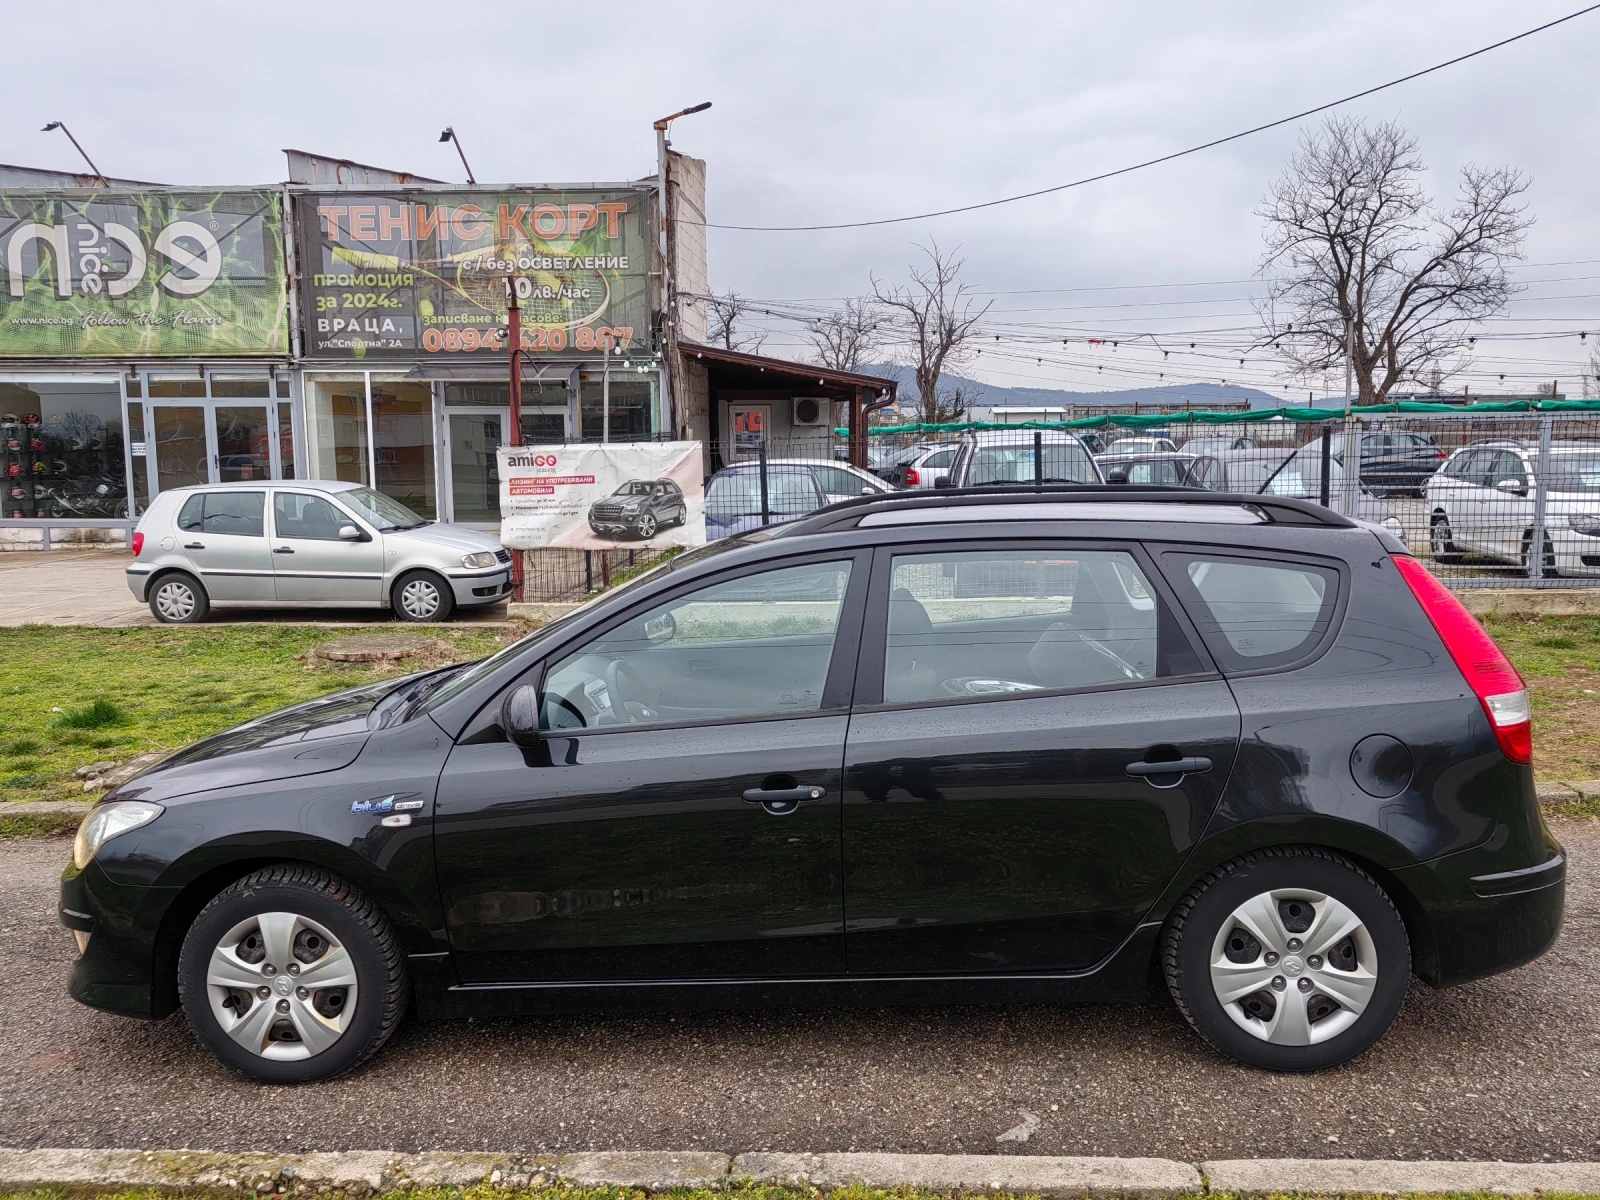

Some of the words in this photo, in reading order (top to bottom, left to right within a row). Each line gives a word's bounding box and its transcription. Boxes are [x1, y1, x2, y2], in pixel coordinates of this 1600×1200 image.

[317, 204, 484, 241] ТЕНИС
[498, 202, 628, 240] КОРТ
[486, 257, 514, 273] без
[518, 256, 629, 270] ОСВЕТЛЕНИЕ
[313, 273, 414, 288] ПРОМОЦИЯ
[316, 296, 337, 312] за
[341, 293, 403, 308] 2024г.
[11, 316, 74, 326] www.nice.bg
[80, 310, 131, 329] Follow
[134, 311, 164, 325] the
[170, 309, 225, 328] Flavor
[317, 318, 403, 334] ВРАЦА,
[423, 314, 492, 326] записване
[422, 327, 503, 353] 0894
[575, 326, 634, 352] 887
[545, 476, 593, 484] УПОТРЕБЯВАНИ
[351, 800, 393, 815] blue
